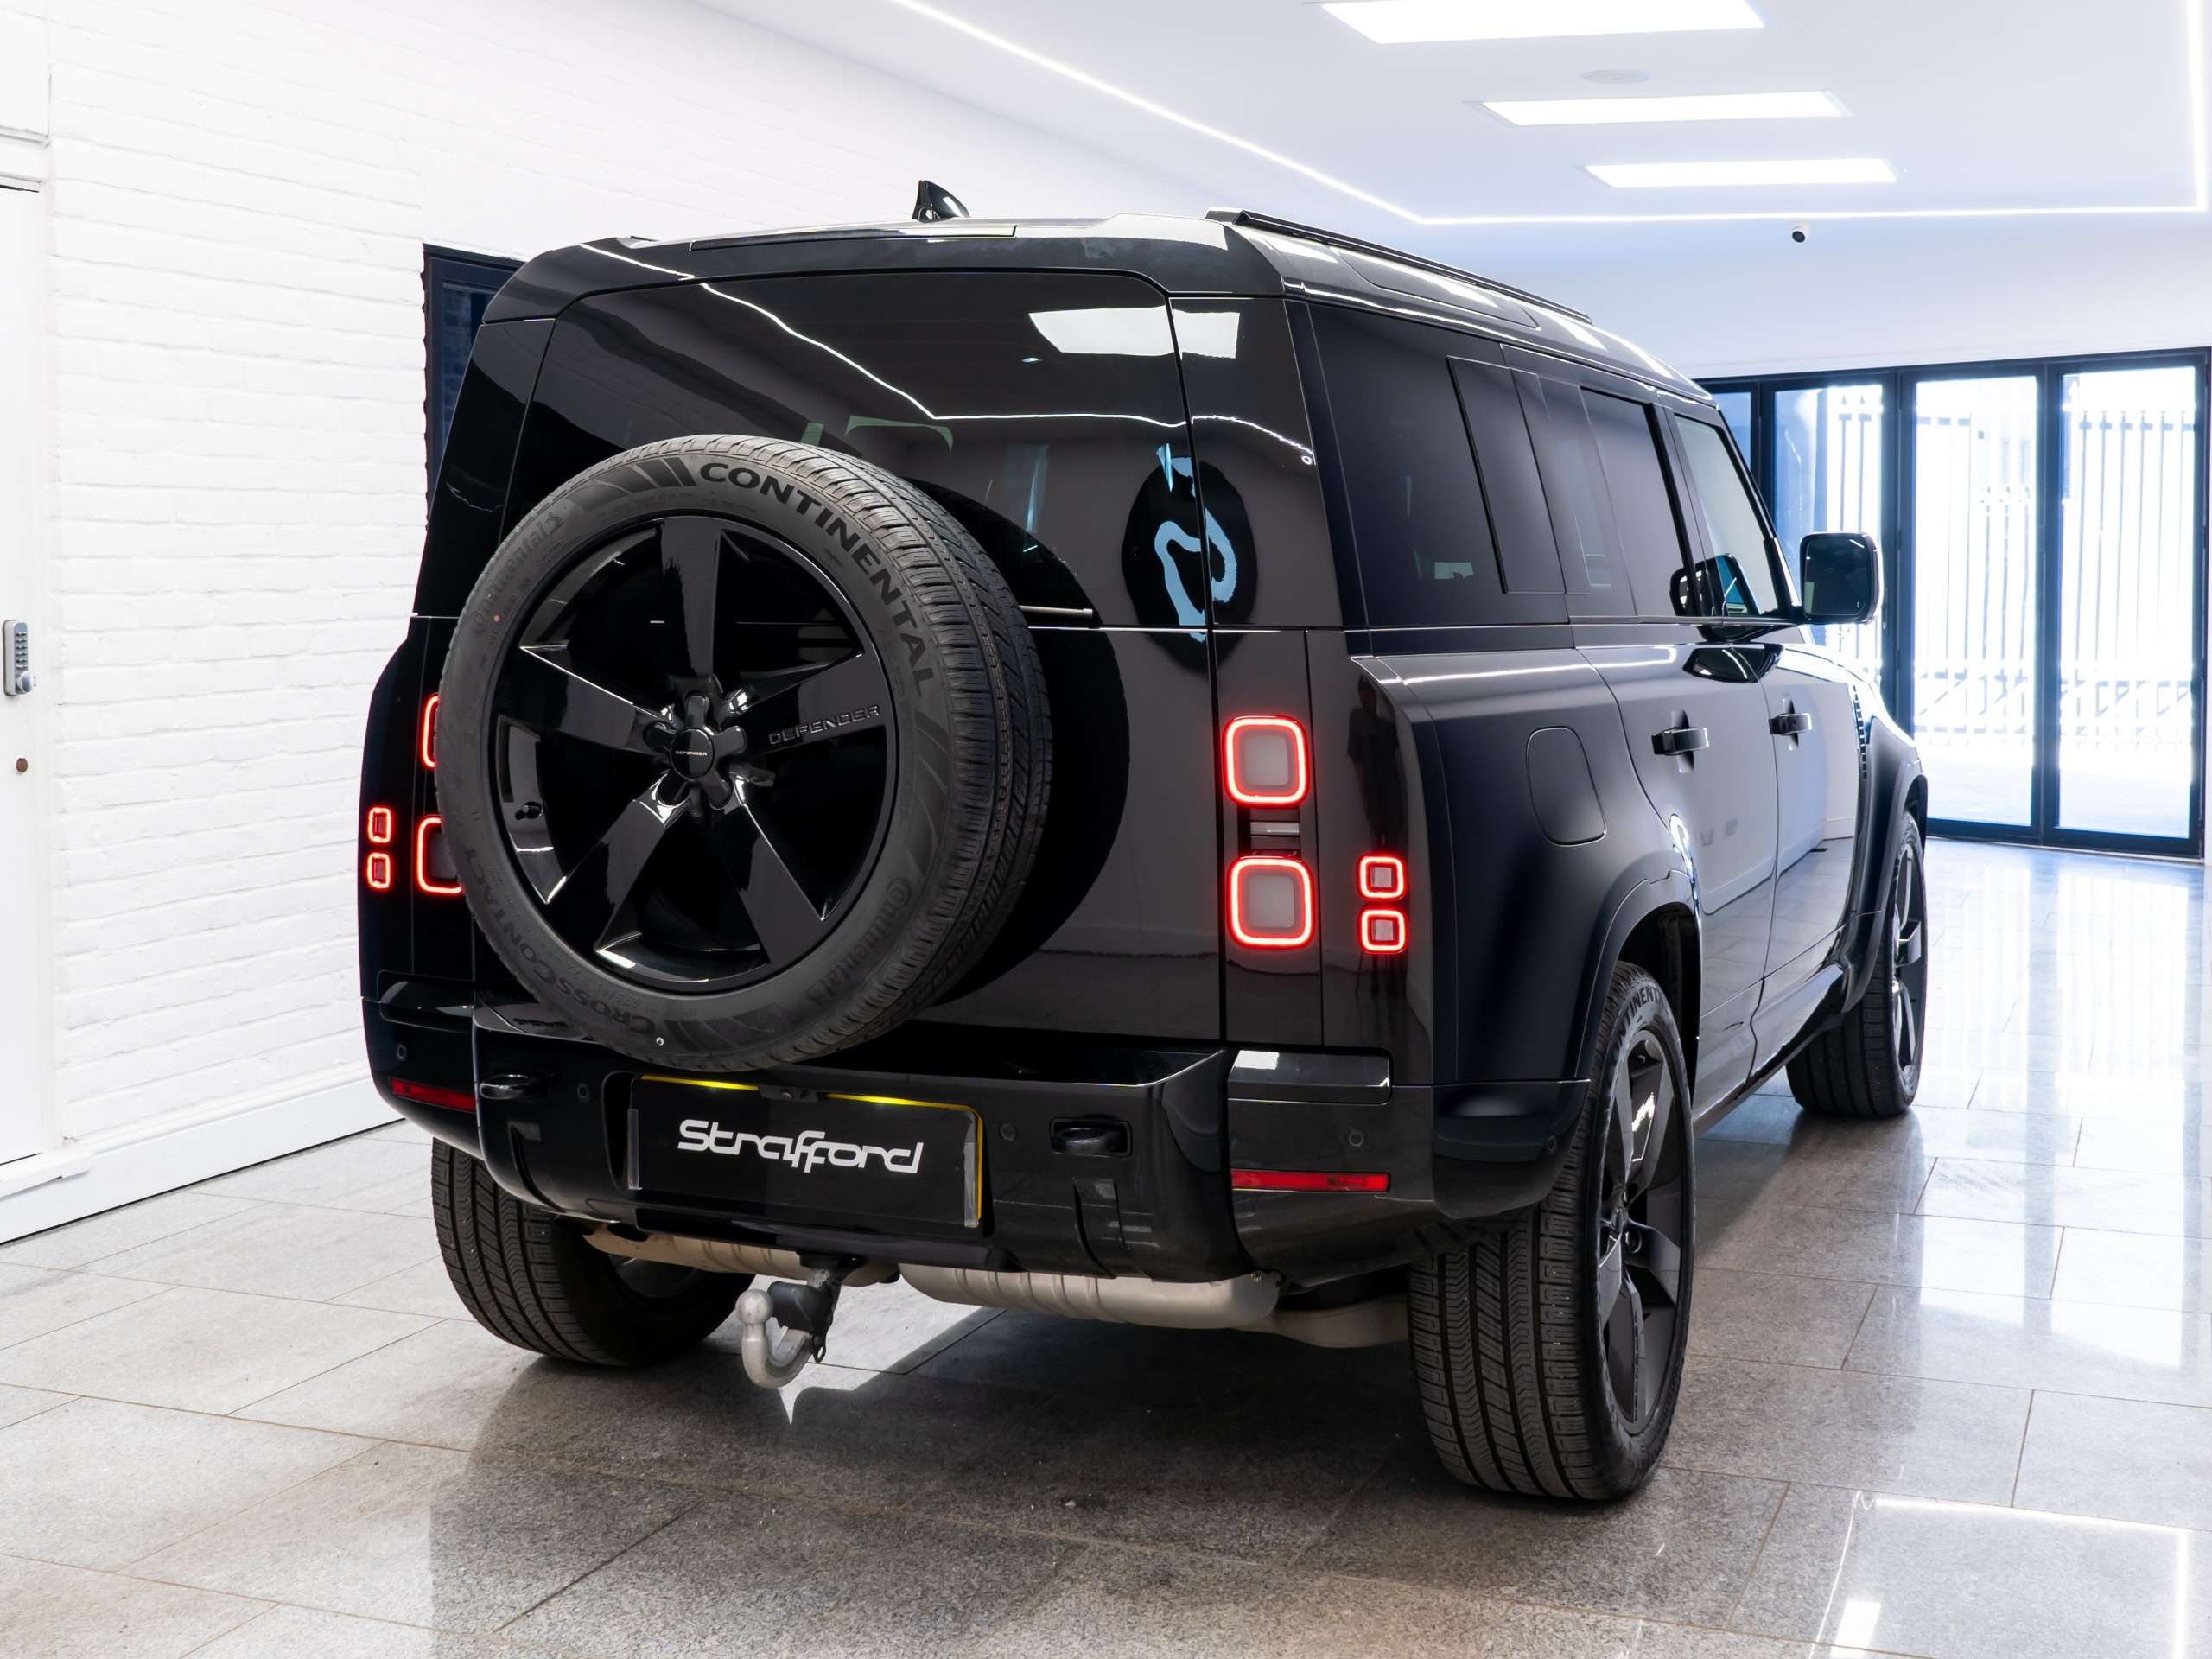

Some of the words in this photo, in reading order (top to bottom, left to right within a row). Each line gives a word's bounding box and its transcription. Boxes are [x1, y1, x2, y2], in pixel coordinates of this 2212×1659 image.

[699, 461, 936, 697] CONTINENTAL
[768, 705, 881, 745] DEFENDER
[677, 1118, 925, 1173] Strafford
